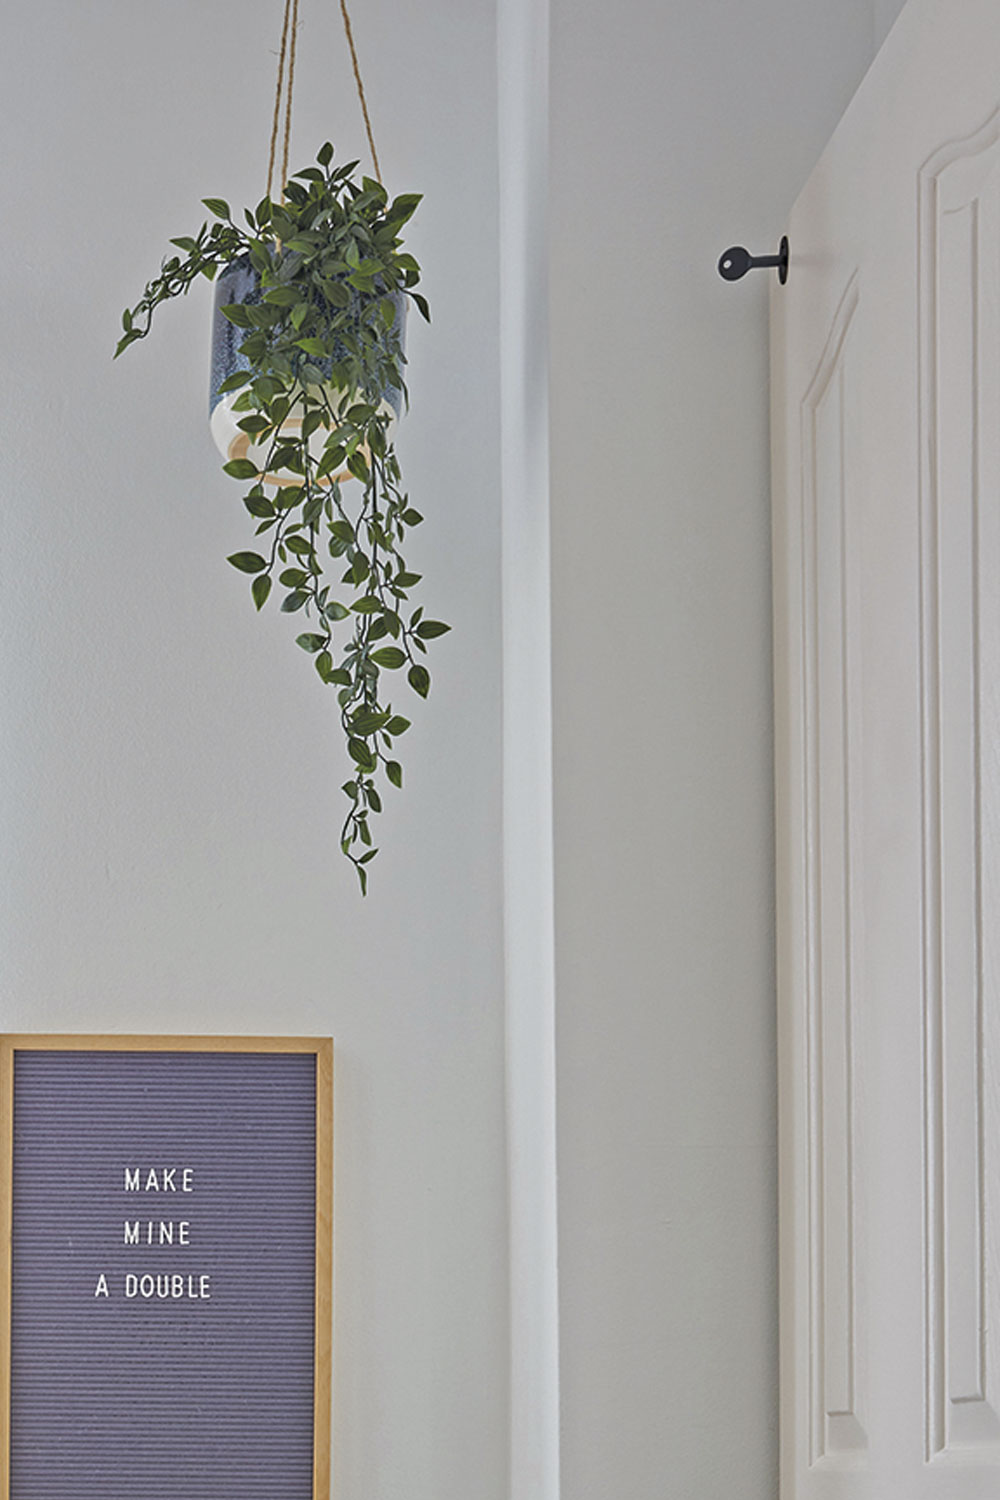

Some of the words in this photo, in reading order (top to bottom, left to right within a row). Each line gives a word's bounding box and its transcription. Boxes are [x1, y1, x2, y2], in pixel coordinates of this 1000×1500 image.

[125, 1167, 194, 1192] MAKE
[124, 1221, 190, 1245] MINE
[95, 1274, 109, 1297] A
[125, 1274, 211, 1298] DOUBLE
